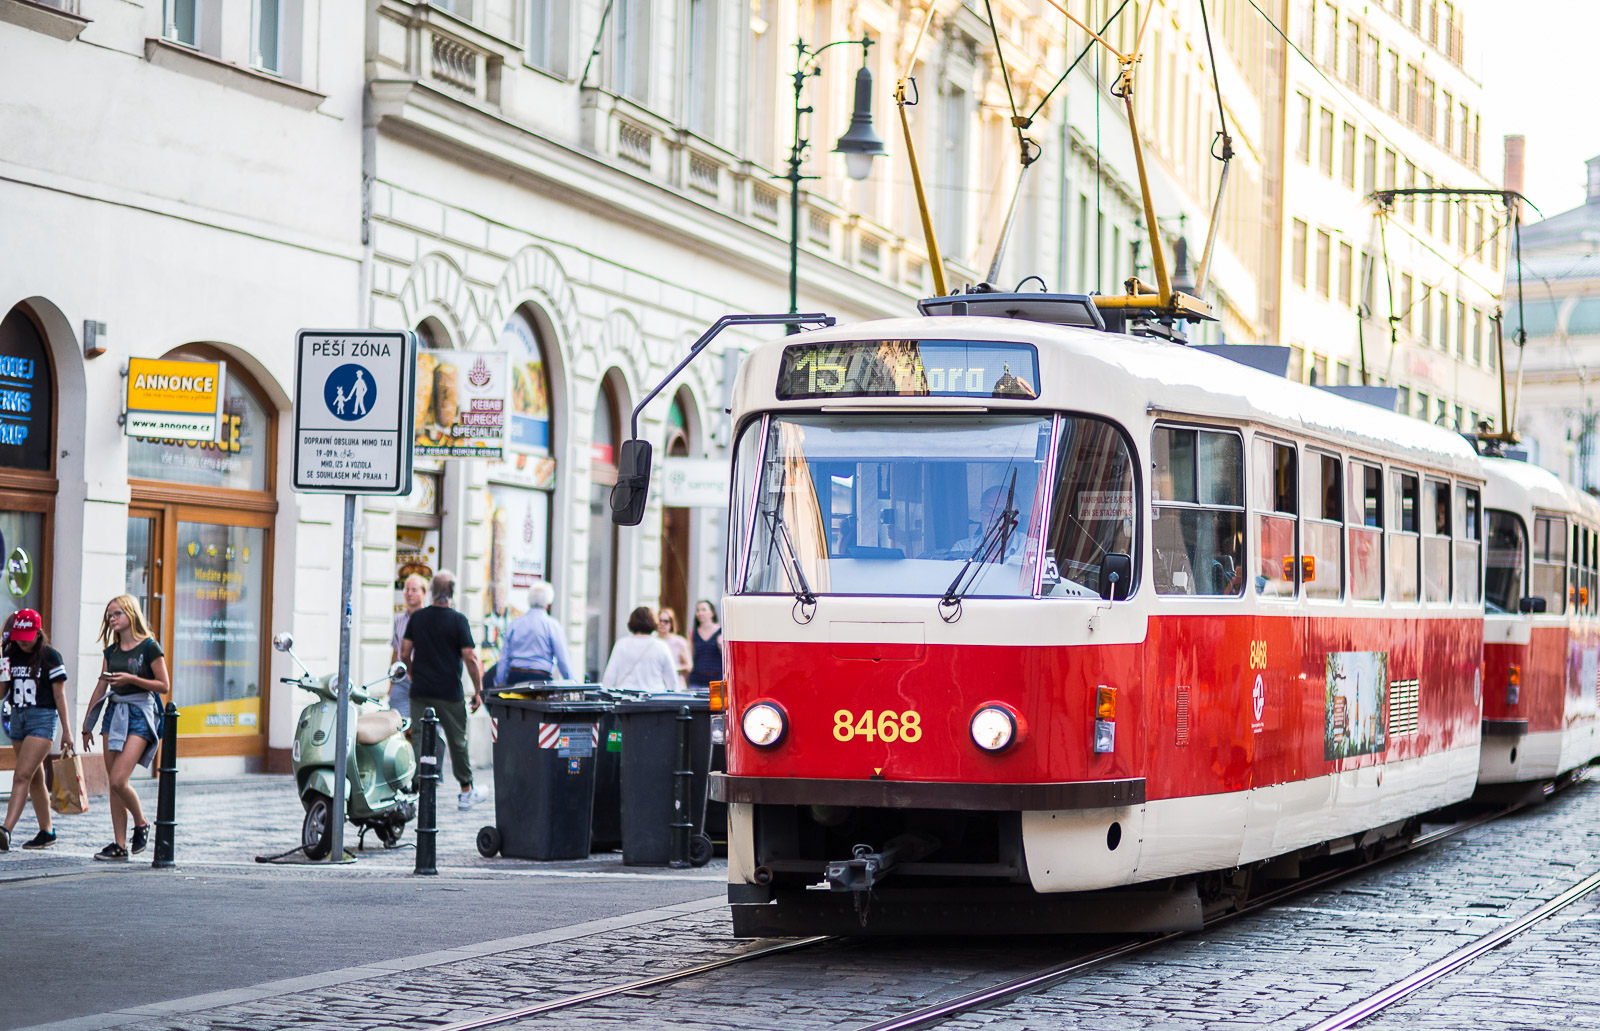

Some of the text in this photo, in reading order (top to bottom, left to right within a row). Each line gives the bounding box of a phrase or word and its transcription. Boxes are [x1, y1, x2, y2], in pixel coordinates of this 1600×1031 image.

[312, 340, 391, 357] PĚŠÍ ZÓNA
[797, 353, 846, 392] 15
[134, 374, 213, 393] ANNONCE
[472, 400, 502, 410] KEBAB
[132, 420, 210, 432] www.annonce.cz
[304, 436, 332, 445] DOPRAVNÍ
[334, 437, 359, 446] OBSLUHA
[380, 439, 393, 447] TAXI
[345, 461, 350, 469] A
[351, 461, 372, 469] VOZIDLA
[306, 471, 314, 479] SE
[316, 471, 350, 480] SOUHLASEM
[352, 471, 361, 480] MČ
[363, 473, 381, 481] PRAHA
[1092, 509, 1099, 517] SE
[1250, 640, 1267, 669] 8468
[833, 709, 922, 743] 8468
